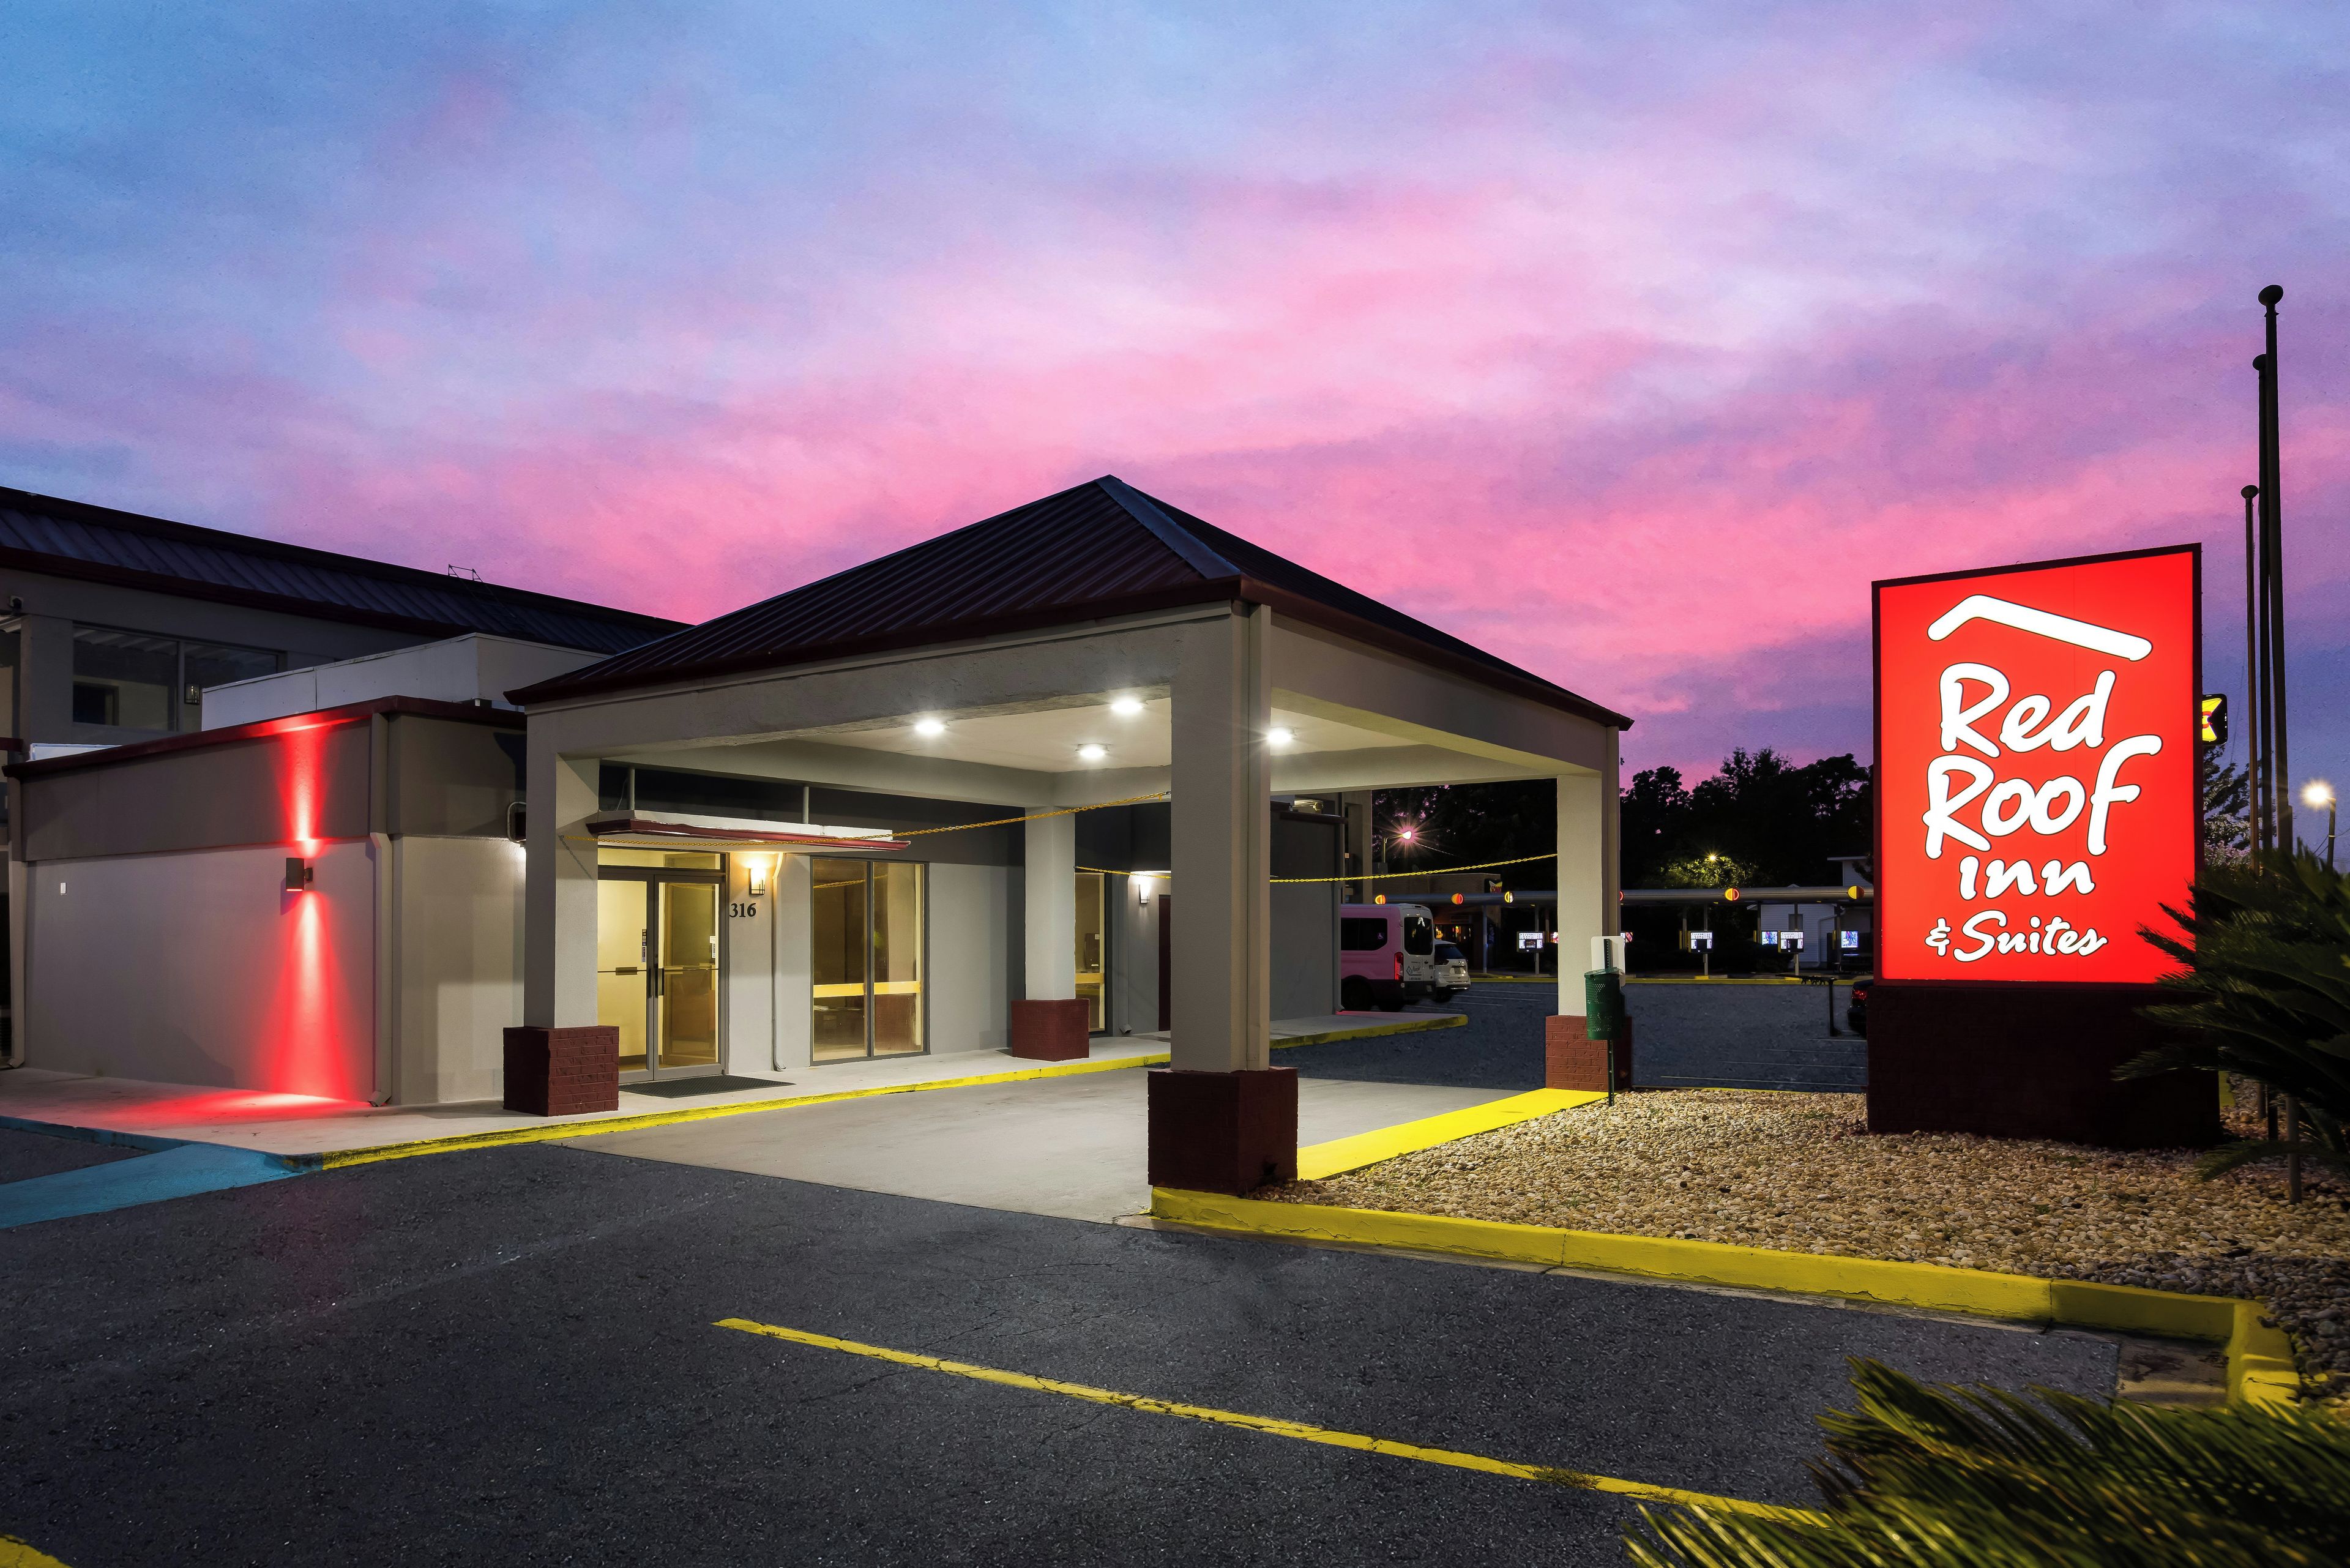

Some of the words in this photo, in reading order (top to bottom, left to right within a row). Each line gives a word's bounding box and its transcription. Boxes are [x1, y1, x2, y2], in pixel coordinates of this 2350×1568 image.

[1939, 662, 2116, 758] Red
[1922, 734, 2163, 859] Roof
[729, 903, 756, 917] 316
[1925, 917, 1952, 957] &
[1953, 909, 2108, 962] Suites
